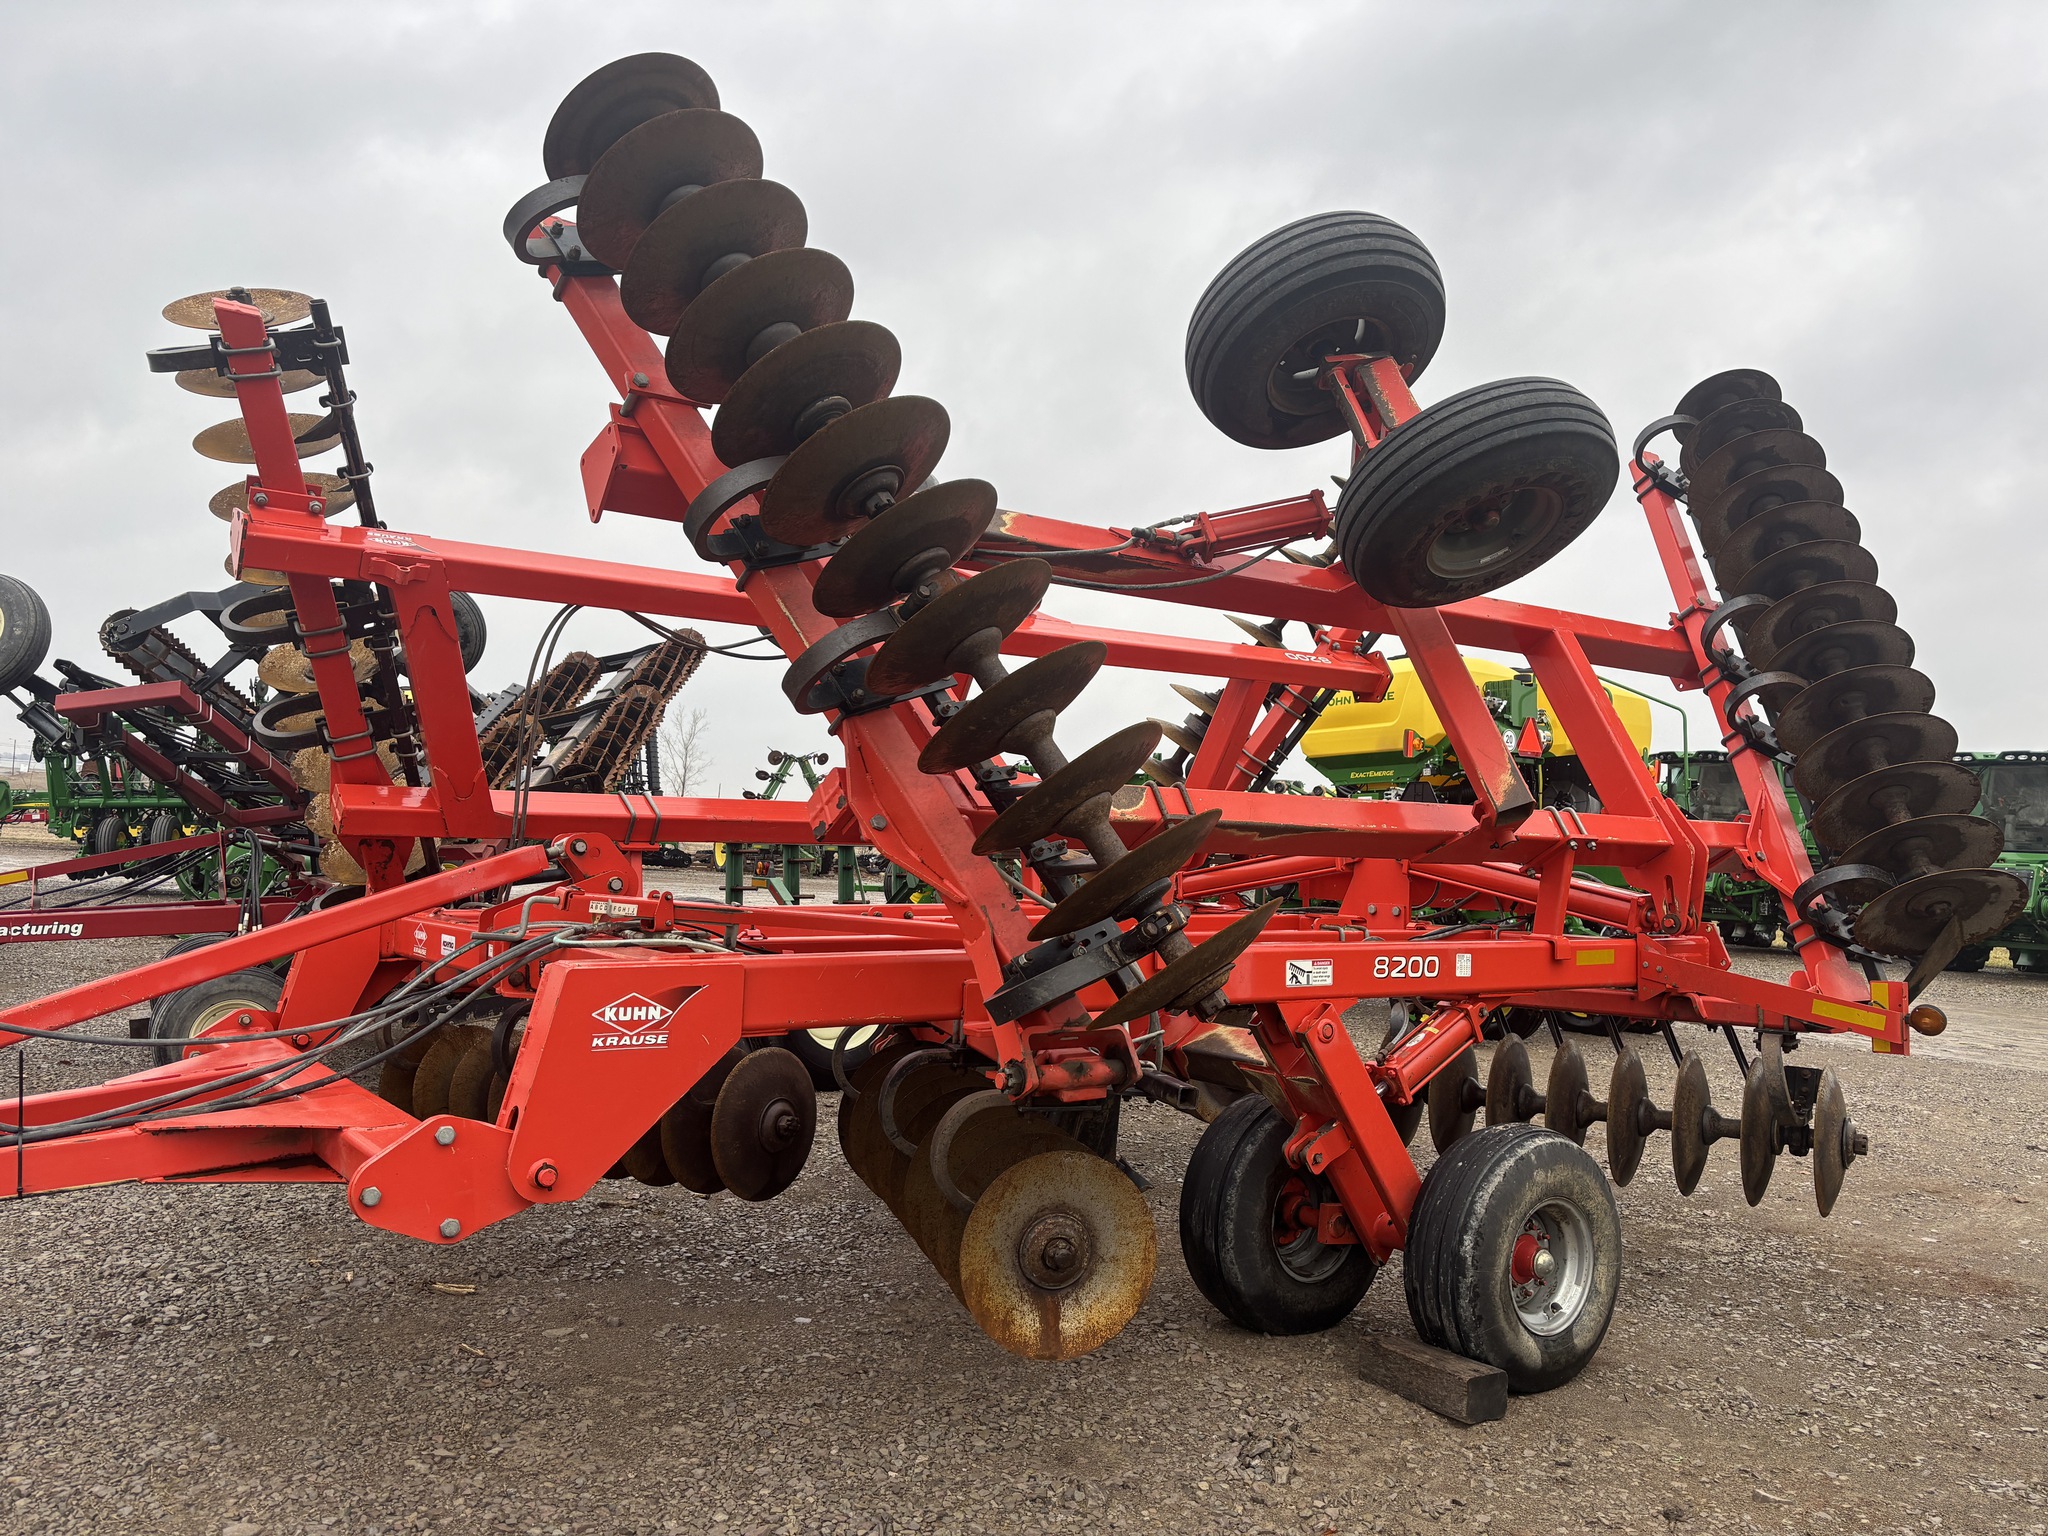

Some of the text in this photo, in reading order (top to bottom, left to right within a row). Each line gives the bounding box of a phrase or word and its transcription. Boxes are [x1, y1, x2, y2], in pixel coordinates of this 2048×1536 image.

[1284, 652, 1332, 664] 8200
[1328, 696, 1352, 706] OHN
[1373, 956, 1440, 978] 8200
[604, 1006, 661, 1022] KUHN
[591, 1035, 669, 1047] KRAUSE
